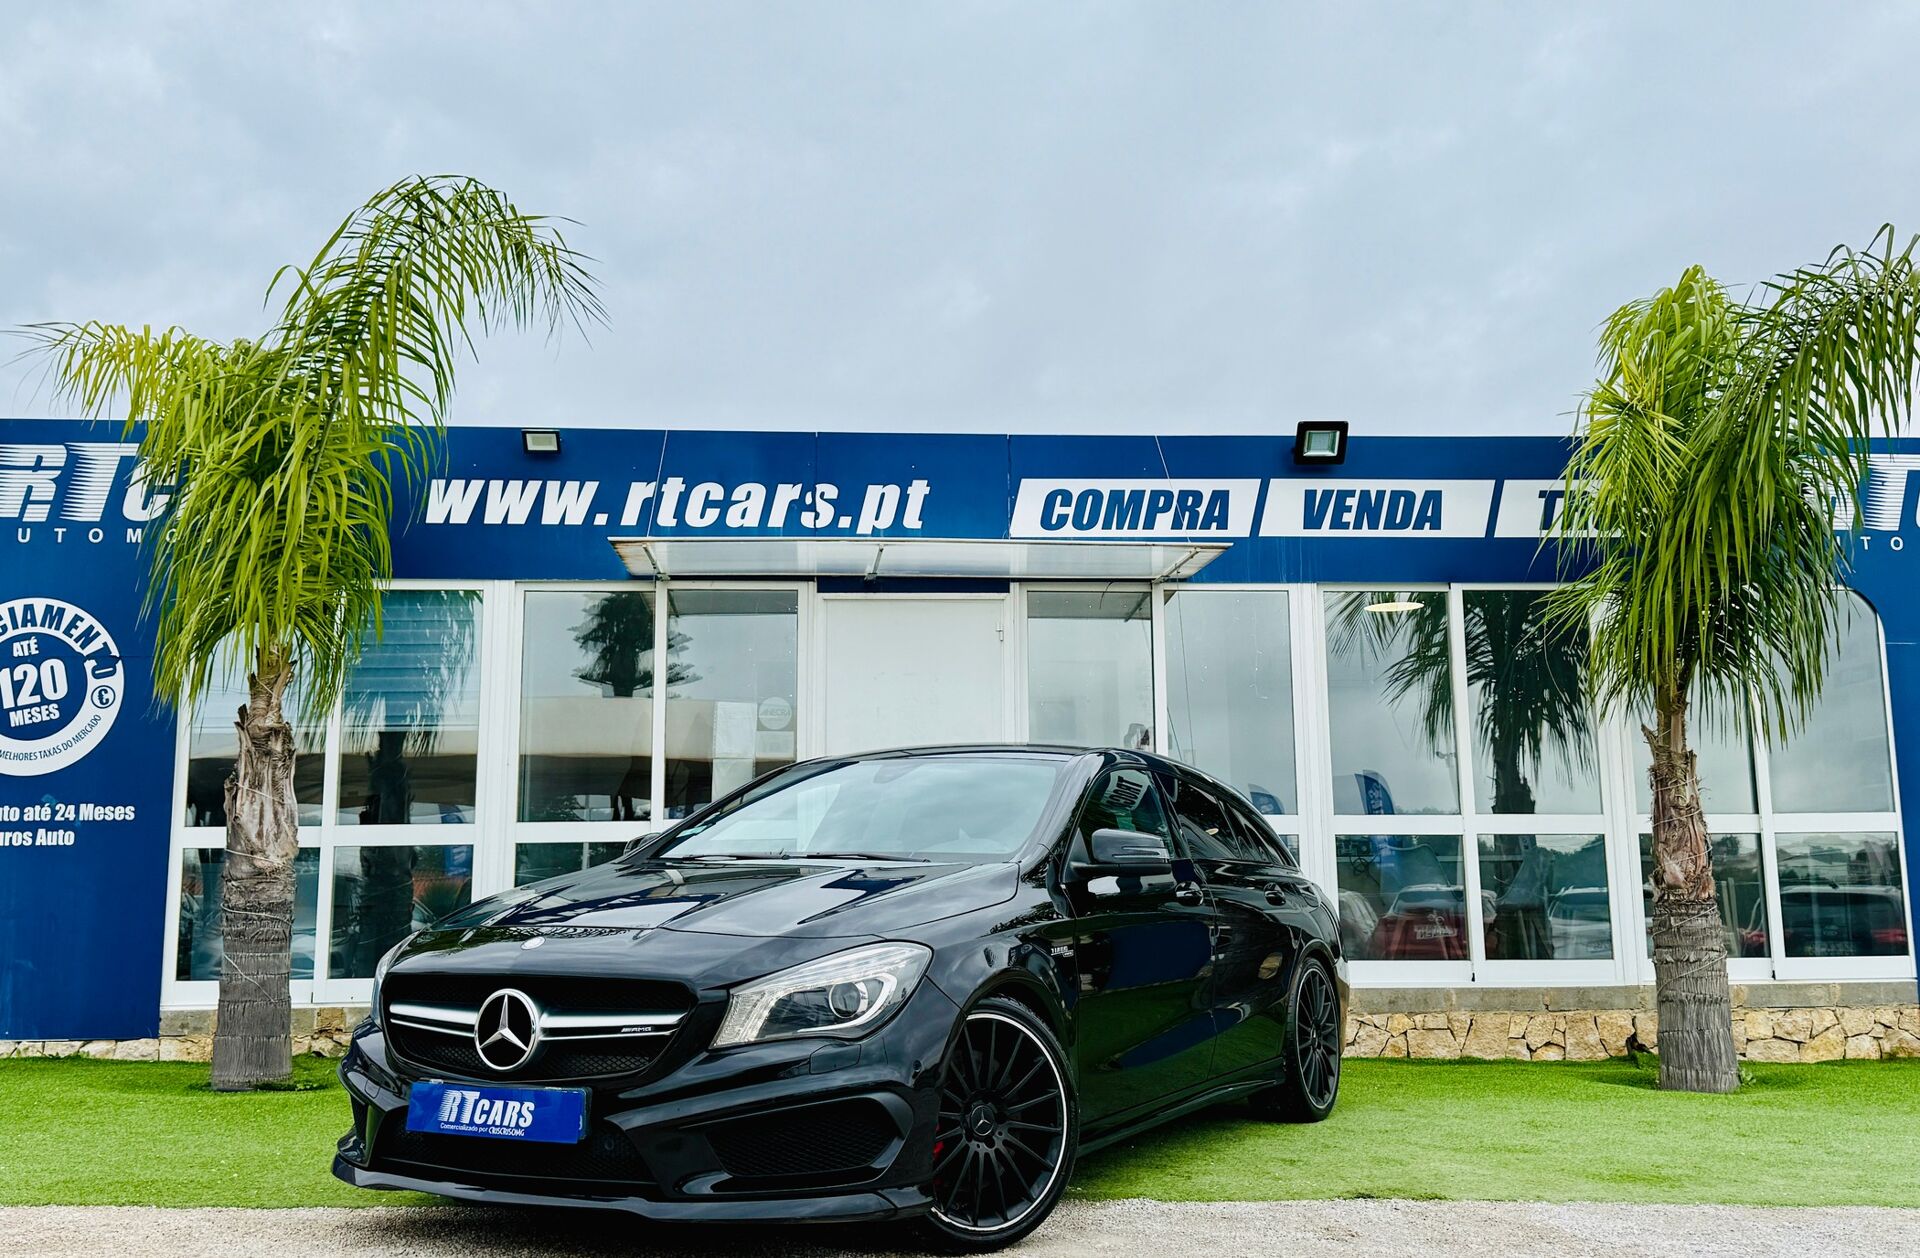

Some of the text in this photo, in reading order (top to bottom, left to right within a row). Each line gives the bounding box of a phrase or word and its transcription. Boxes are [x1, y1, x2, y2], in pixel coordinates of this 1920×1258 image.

[425, 477, 930, 534] www.rtcars.pt
[1039, 488, 1231, 531] COMPRA
[1302, 489, 1443, 530] VENDA
[13, 636, 39, 657] ATÉ
[0, 658, 69, 709] 120
[9, 703, 61, 728] MESES
[38, 745, 62, 759] TAXAS
[61, 740, 73, 751] DO
[71, 714, 102, 744] MERCADO
[0, 803, 136, 821] to até 24 Meses
[35, 828, 75, 846] Auto
[438, 1089, 536, 1128] RTCARS
[440, 1122, 479, 1132] Comercializado
